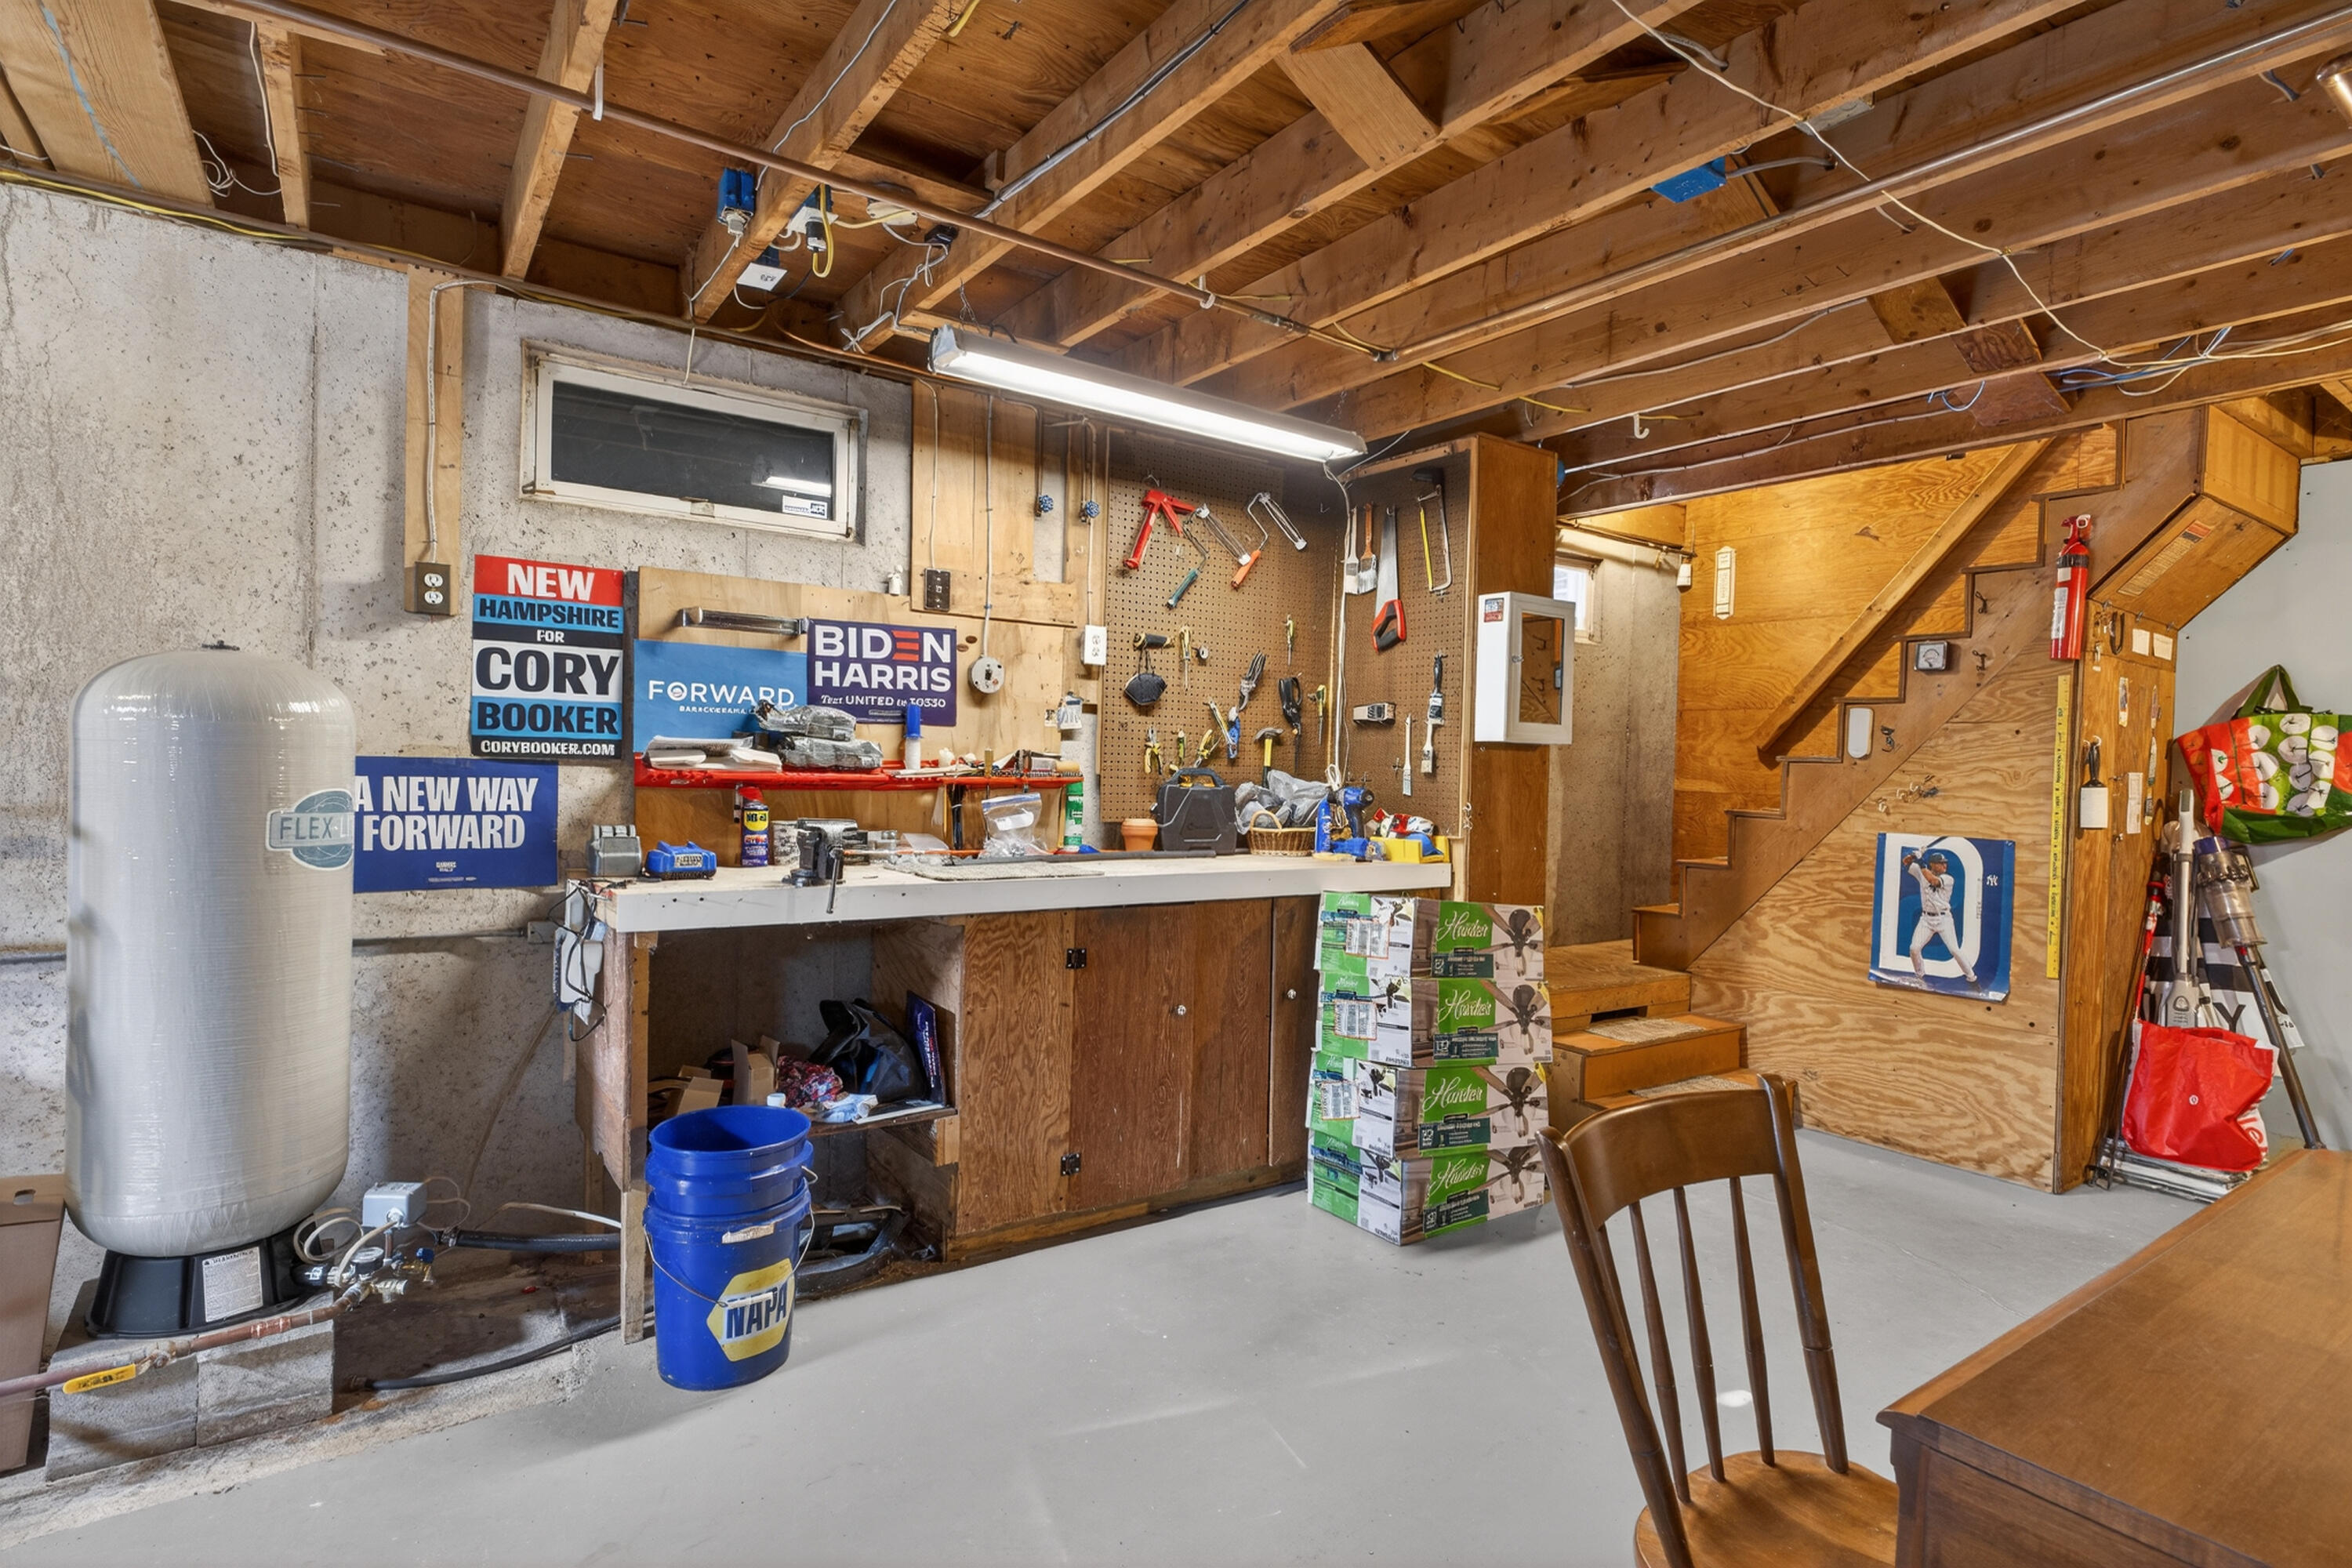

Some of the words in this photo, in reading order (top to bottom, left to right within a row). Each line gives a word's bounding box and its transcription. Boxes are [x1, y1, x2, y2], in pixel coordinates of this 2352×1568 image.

[507, 563, 595, 601] NEW
[479, 598, 619, 628] HAMPSHIRE
[536, 629, 564, 643] FOR
[815, 625, 951, 662] BIDEN
[476, 647, 619, 695] CORY
[815, 661, 951, 692] HARRIS
[648, 680, 794, 706] FORWARD
[845, 695, 894, 706] UNITED
[477, 702, 618, 735] BOOKER
[481, 739, 615, 756] CORYBOOKER.COM
[355, 775, 374, 811] A
[383, 776, 459, 811] NEW
[467, 777, 539, 812] WAY
[363, 815, 525, 851] FORWARD
[726, 1279, 788, 1339] NAPA
